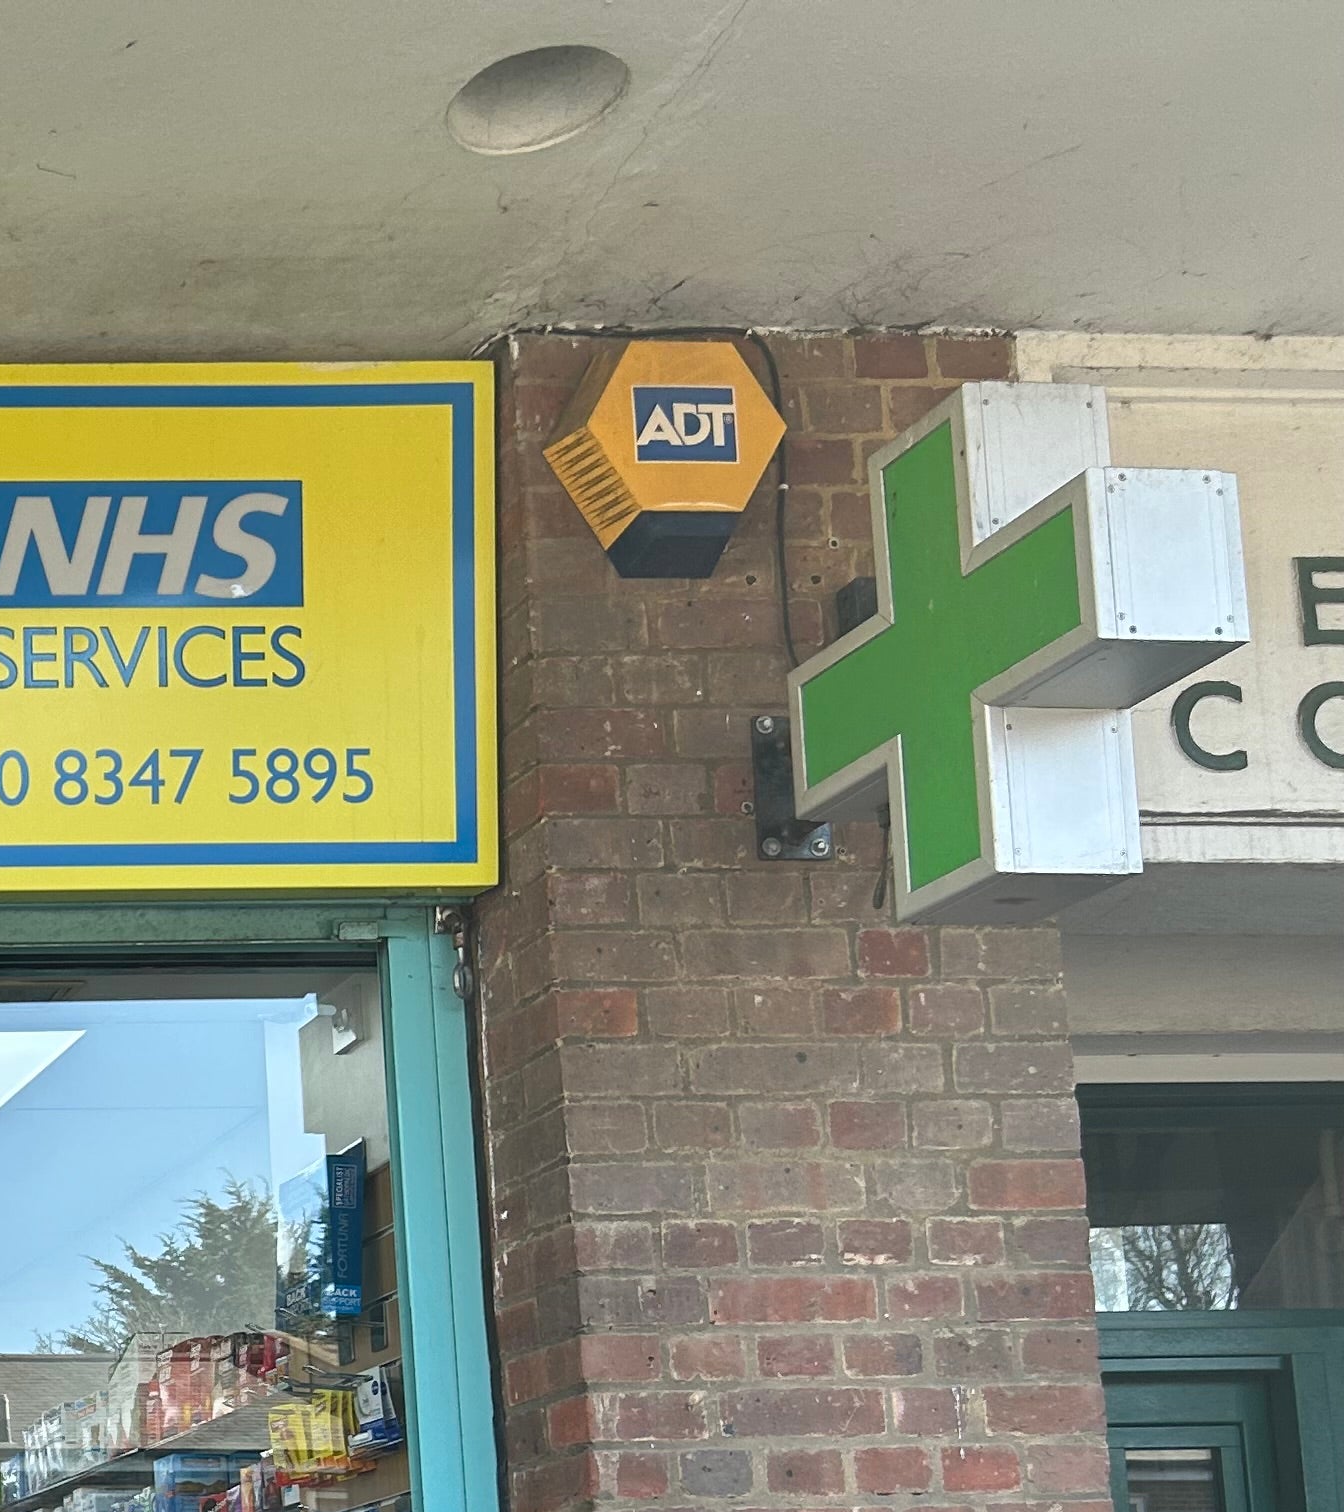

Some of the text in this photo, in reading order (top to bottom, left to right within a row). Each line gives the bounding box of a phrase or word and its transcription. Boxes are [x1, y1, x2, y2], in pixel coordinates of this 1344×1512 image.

[637, 402, 734, 446] ADT
[53, 747, 204, 805] 8347
[228, 747, 375, 804] 5895
